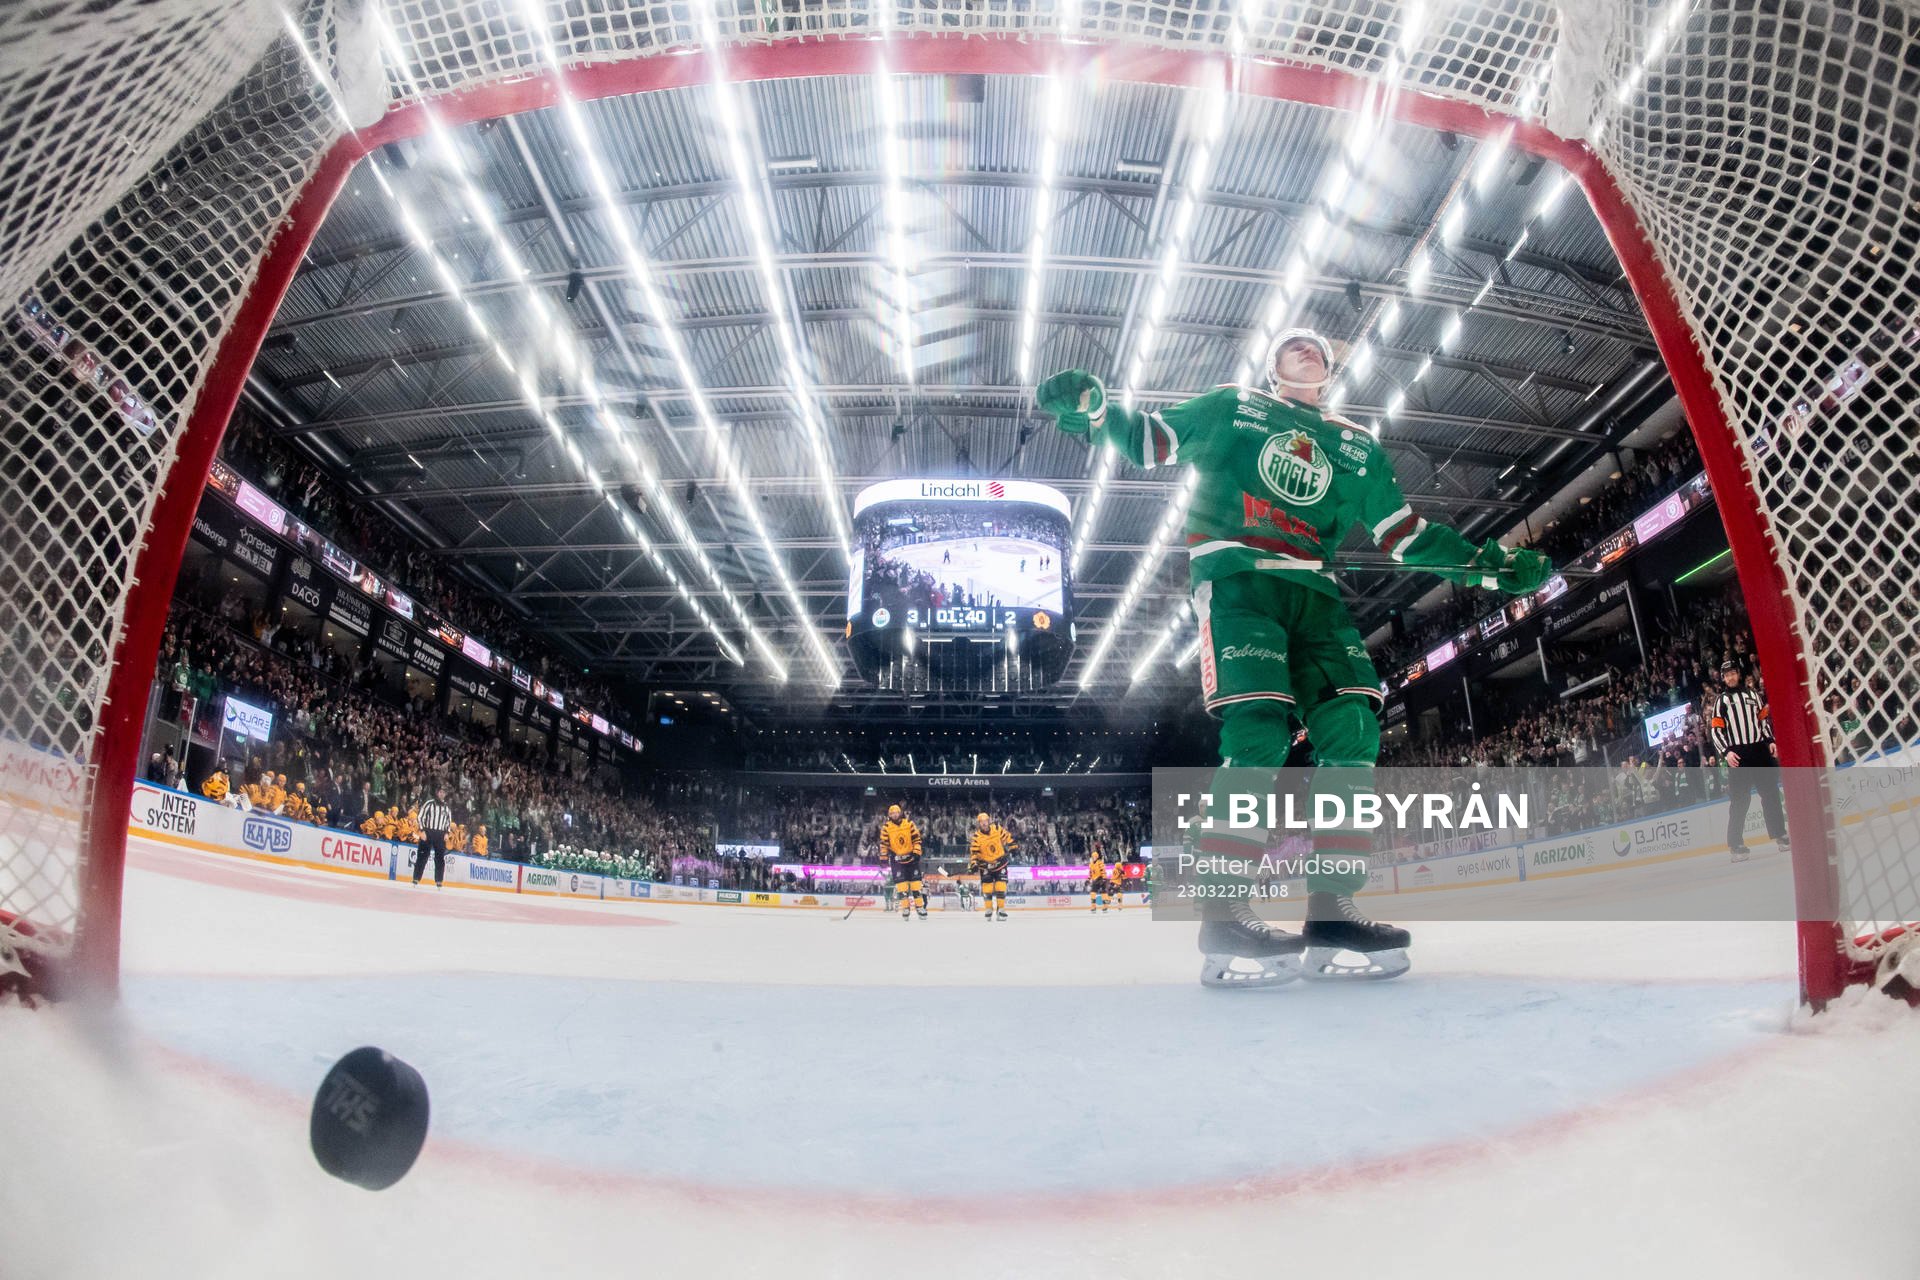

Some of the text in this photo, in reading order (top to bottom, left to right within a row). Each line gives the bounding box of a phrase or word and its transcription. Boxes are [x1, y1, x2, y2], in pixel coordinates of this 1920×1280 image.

[1236, 405, 1268, 420] SSE
[1268, 454, 1321, 496] RÖGLE
[921, 483, 980, 497] Lindahl
[291, 583, 320, 607] DACO
[907, 610, 1016, 624] 3 01:40 2
[477, 684, 489, 698] EY
[928, 777, 990, 786] CATENA Arena
[161, 793, 197, 817] INTER
[147, 808, 196, 836] SYSTEM
[1635, 820, 1690, 845] BJÄRE
[246, 821, 290, 847] KAABS
[321, 837, 383, 867] CATENA
[1533, 844, 1586, 866] AGRIZON
[1636, 838, 1691, 855] MARKKONSULT
[470, 863, 513, 884] NORRVIDINGE
[1457, 855, 1511, 877] eyes4work
[526, 873, 557, 886] AGRIZON
[1005, 896, 1026, 905] ravida
